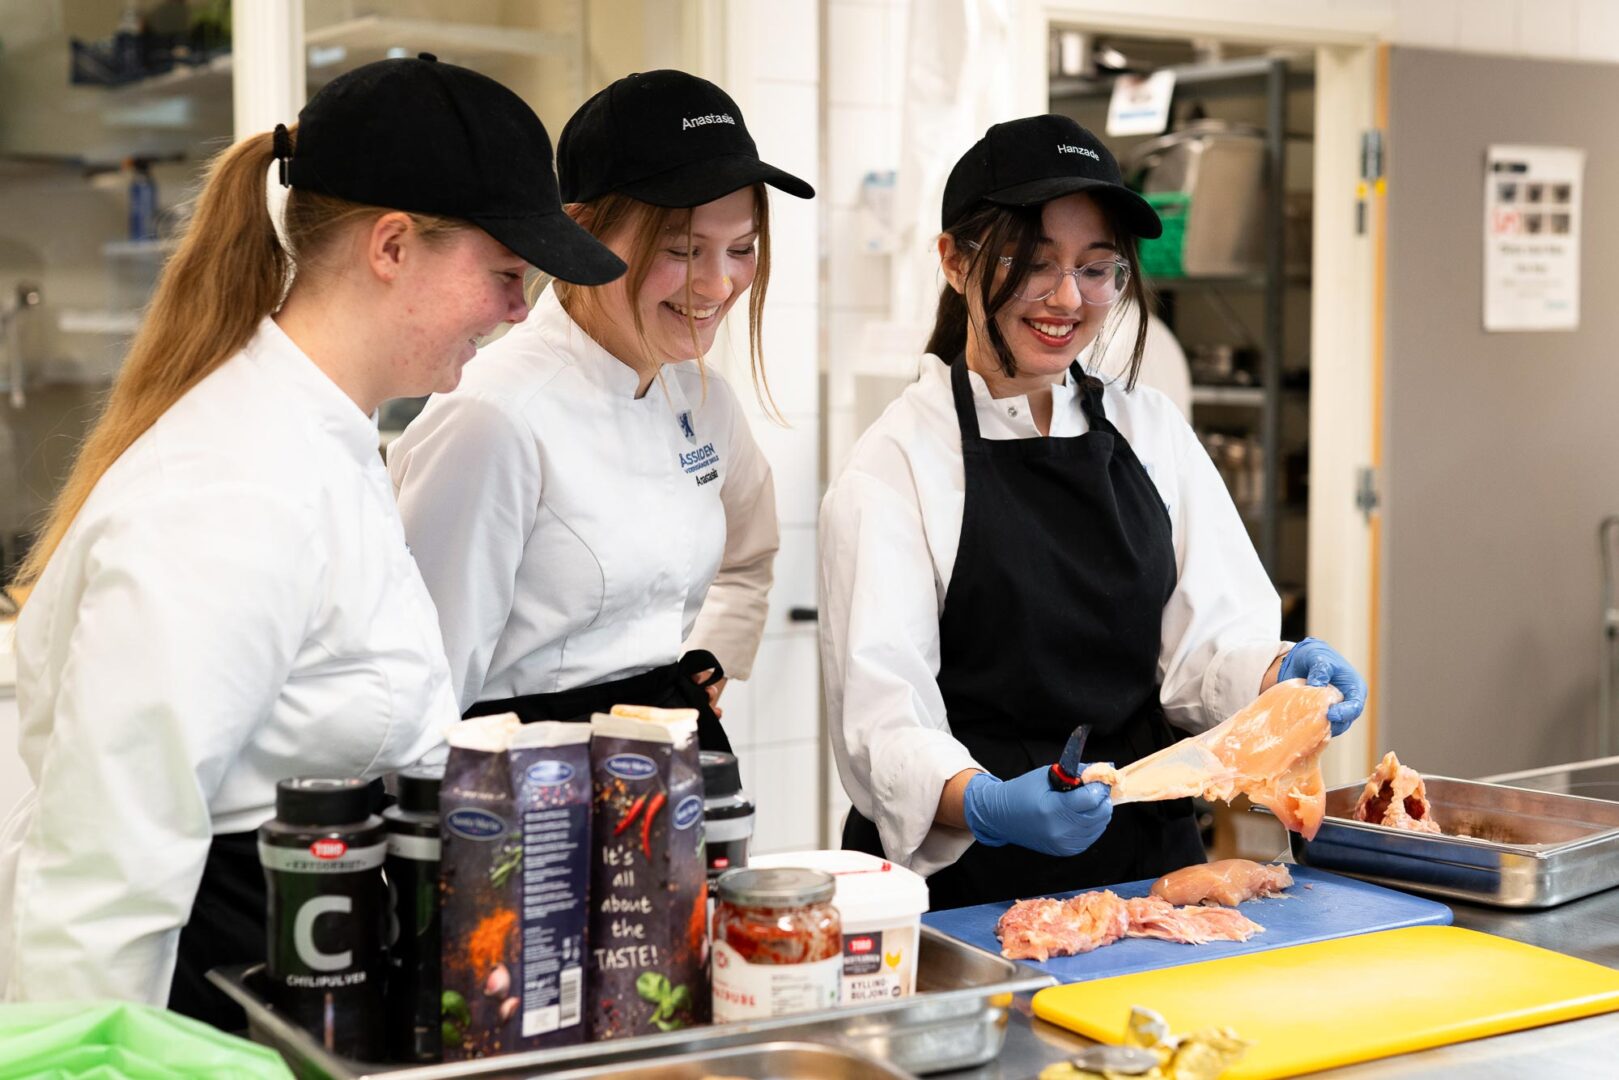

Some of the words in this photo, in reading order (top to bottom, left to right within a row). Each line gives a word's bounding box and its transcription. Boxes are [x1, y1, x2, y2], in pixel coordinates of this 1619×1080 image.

[682, 113, 736, 131] Anastasia
[1056, 143, 1101, 162] Hanzade
[602, 844, 634, 867] It's
[612, 870, 635, 887] all
[601, 893, 653, 914] about
[294, 894, 353, 971] C
[611, 918, 646, 939] the
[593, 945, 659, 971] TASTE!
[286, 971, 367, 988] CHILIPULVER
